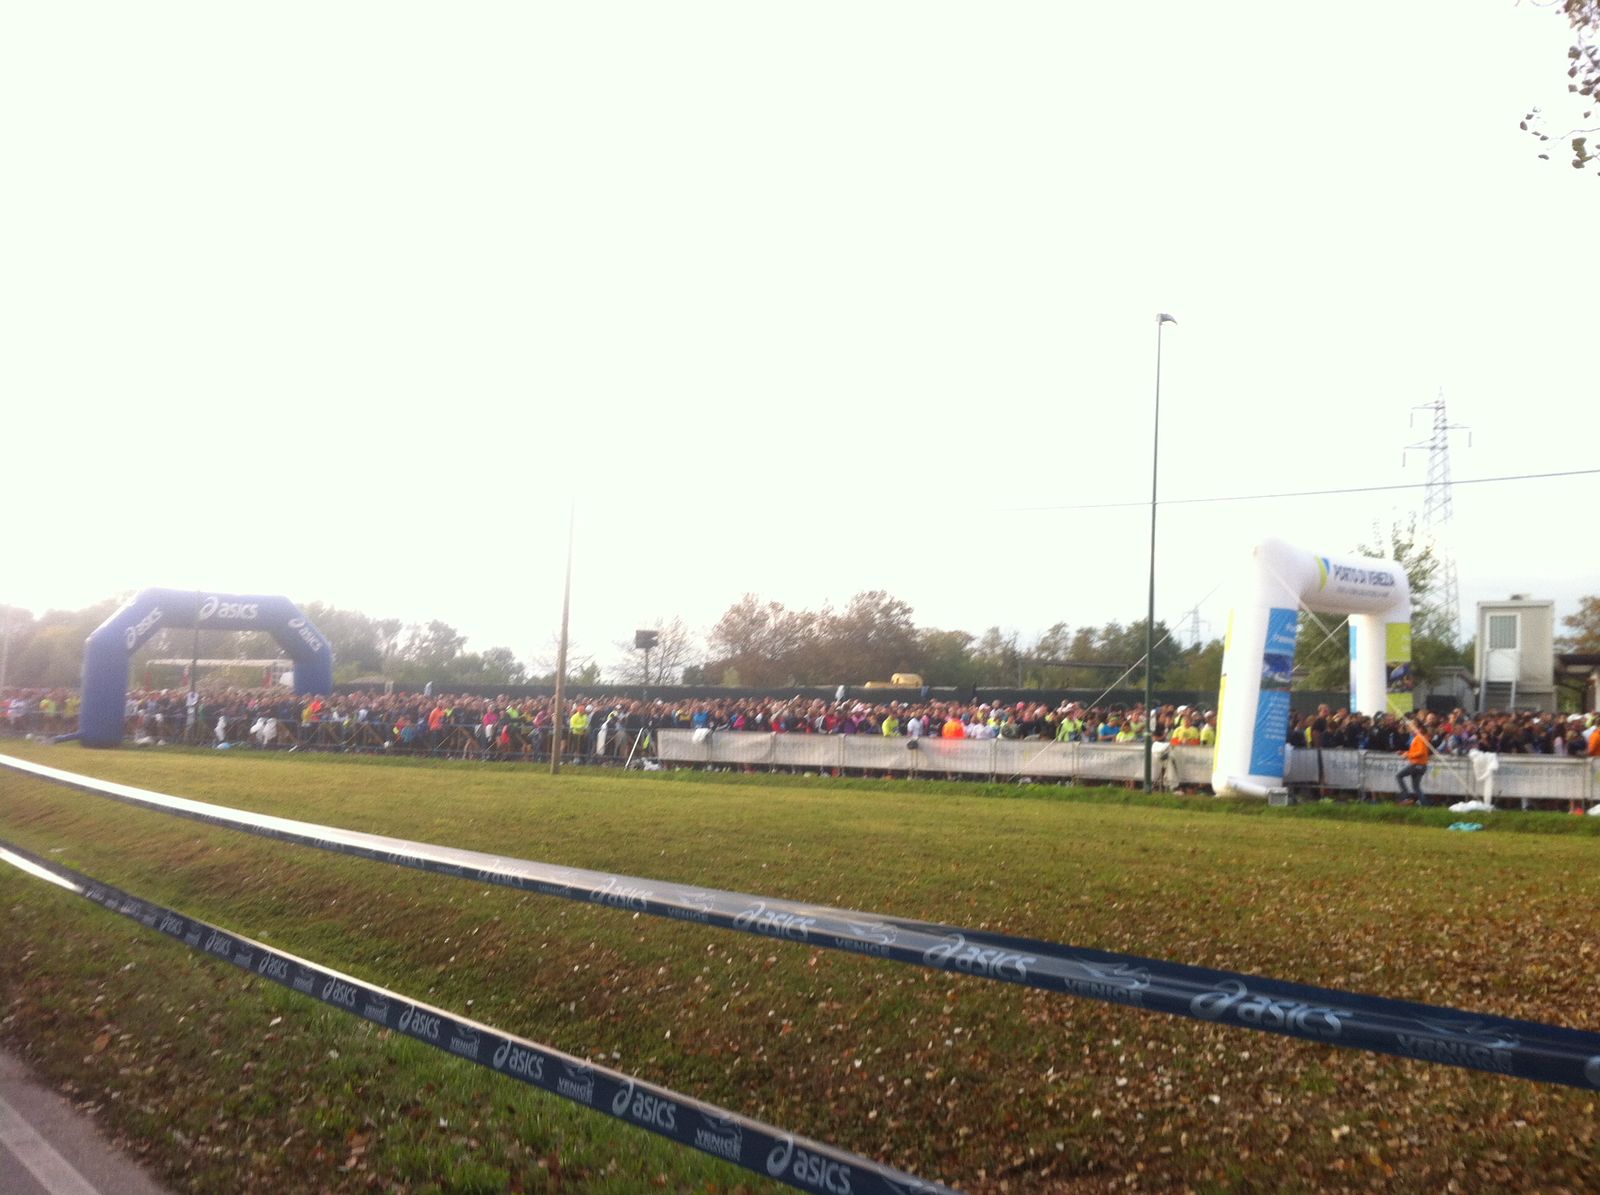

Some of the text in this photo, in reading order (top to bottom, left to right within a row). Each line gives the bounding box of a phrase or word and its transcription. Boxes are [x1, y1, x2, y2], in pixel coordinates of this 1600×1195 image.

[218, 602, 259, 620] asics
[756, 910, 816, 941] asics
[835, 936, 890, 956] VENICE
[267, 957, 289, 979] asics
[955, 948, 1036, 982] asics
[333, 980, 357, 1007] asics
[1064, 977, 1142, 1002] VENICE
[411, 1015, 440, 1040] asics
[1237, 995, 1353, 1037] asics
[509, 1049, 544, 1079] asics
[1396, 1033, 1512, 1069] VENICE
[632, 1092, 676, 1129] asics
[793, 1150, 850, 1195] asics
